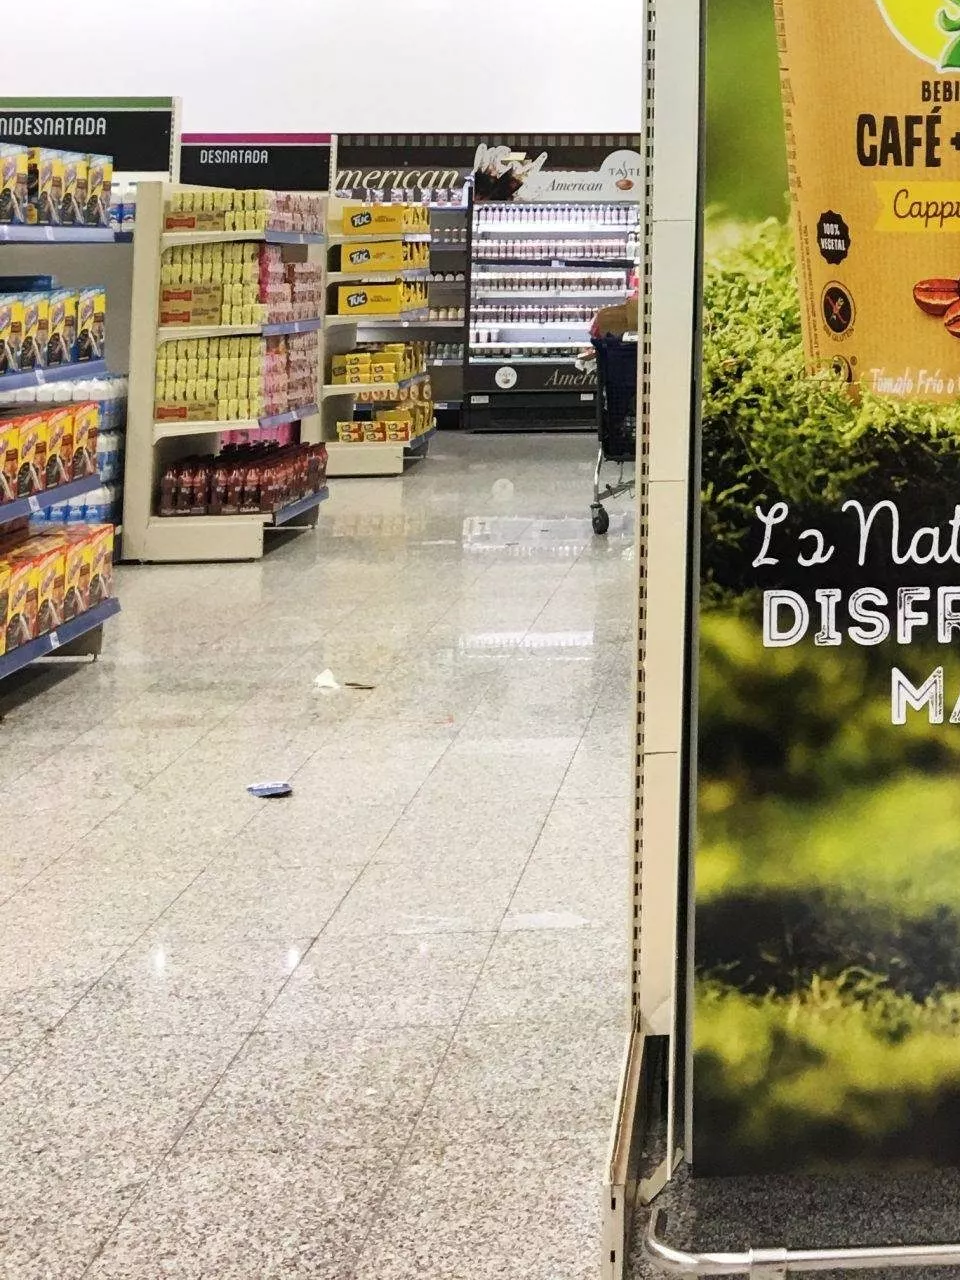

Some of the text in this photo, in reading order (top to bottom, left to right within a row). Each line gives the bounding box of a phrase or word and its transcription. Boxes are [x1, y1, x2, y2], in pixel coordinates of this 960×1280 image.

[856, 106, 942, 168] CAFÉ
[200, 149, 269, 164] DESNATADA
[546, 178, 604, 192] American
[823, 223, 841, 236] 100%
[820, 238, 846, 251] VEGETAL
[916, 366, 945, 395] Frío
